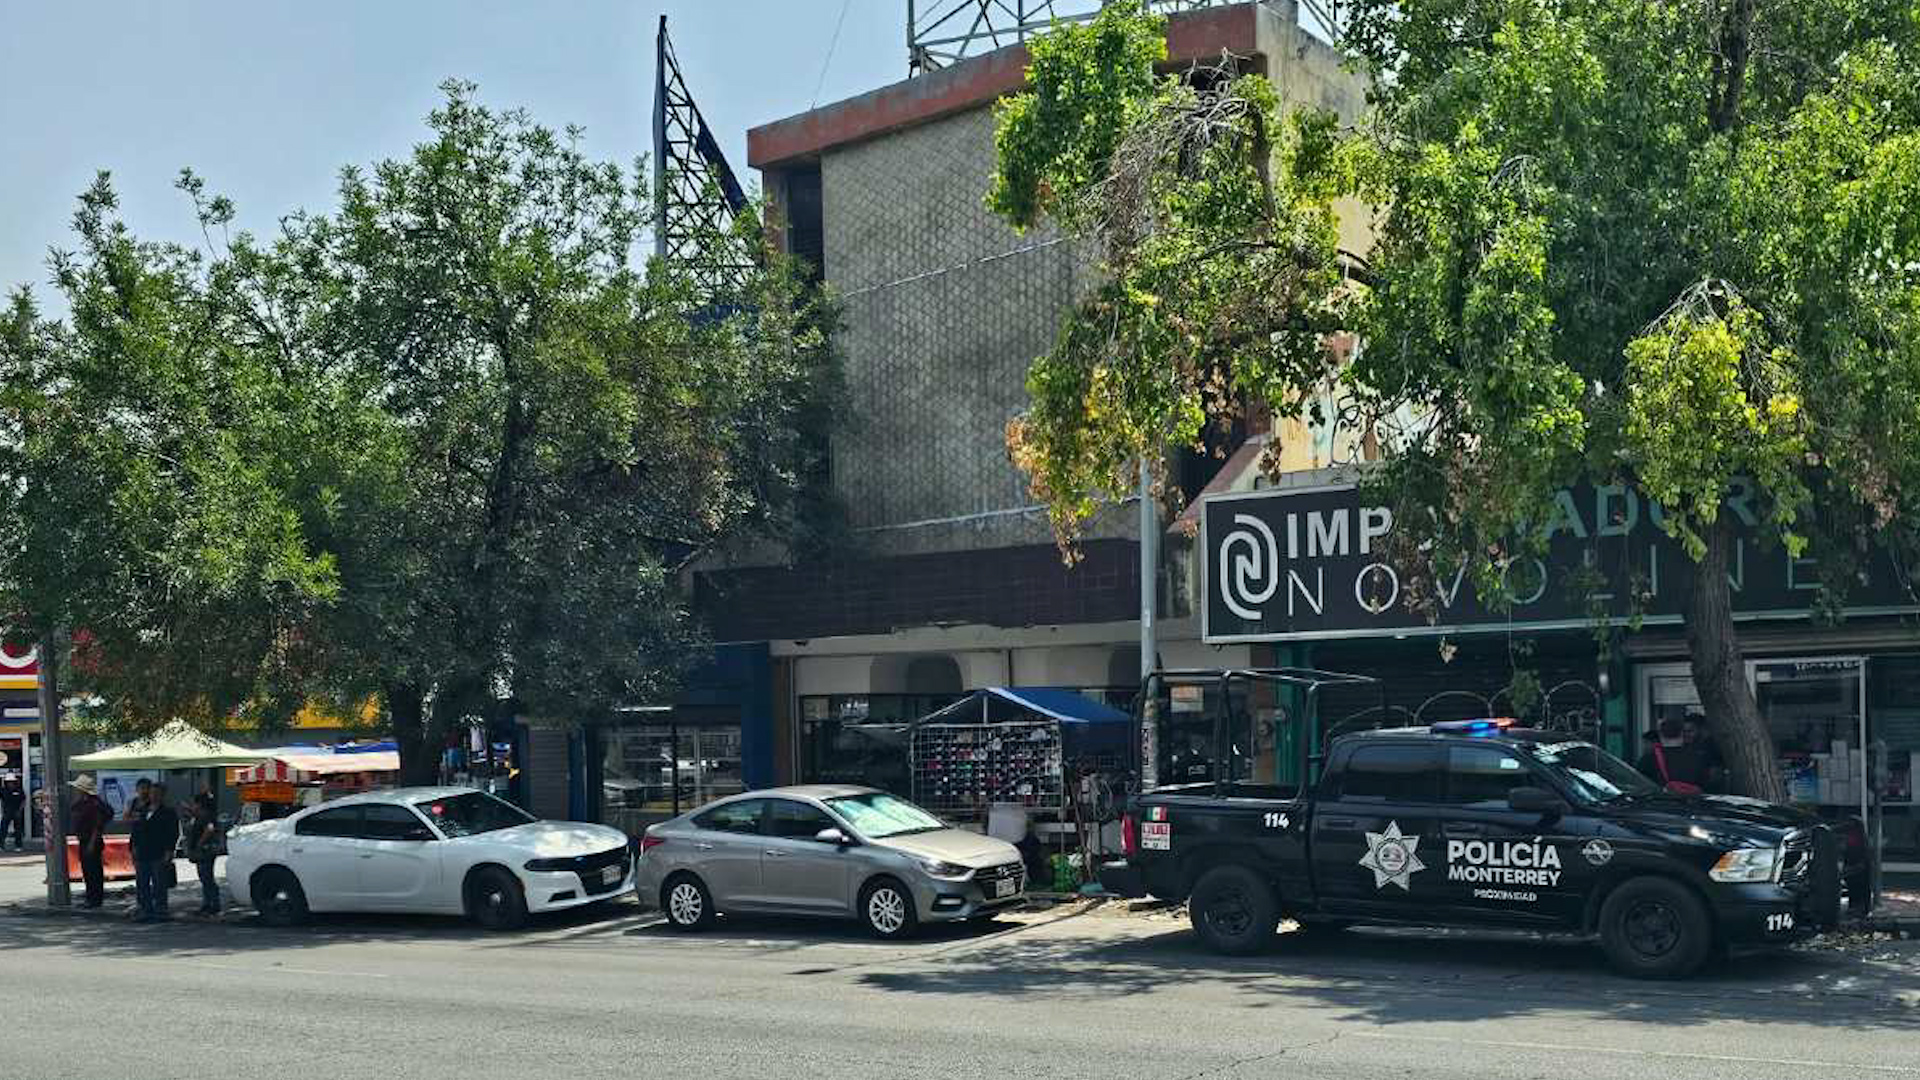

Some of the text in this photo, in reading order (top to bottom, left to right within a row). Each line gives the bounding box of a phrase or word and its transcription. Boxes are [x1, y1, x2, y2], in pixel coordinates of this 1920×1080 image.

[1264, 812, 1290, 828] 114
[1447, 835, 1561, 868] POLICÍA
[1448, 865, 1561, 887] MONTERREY
[1766, 912, 1794, 931] 114
